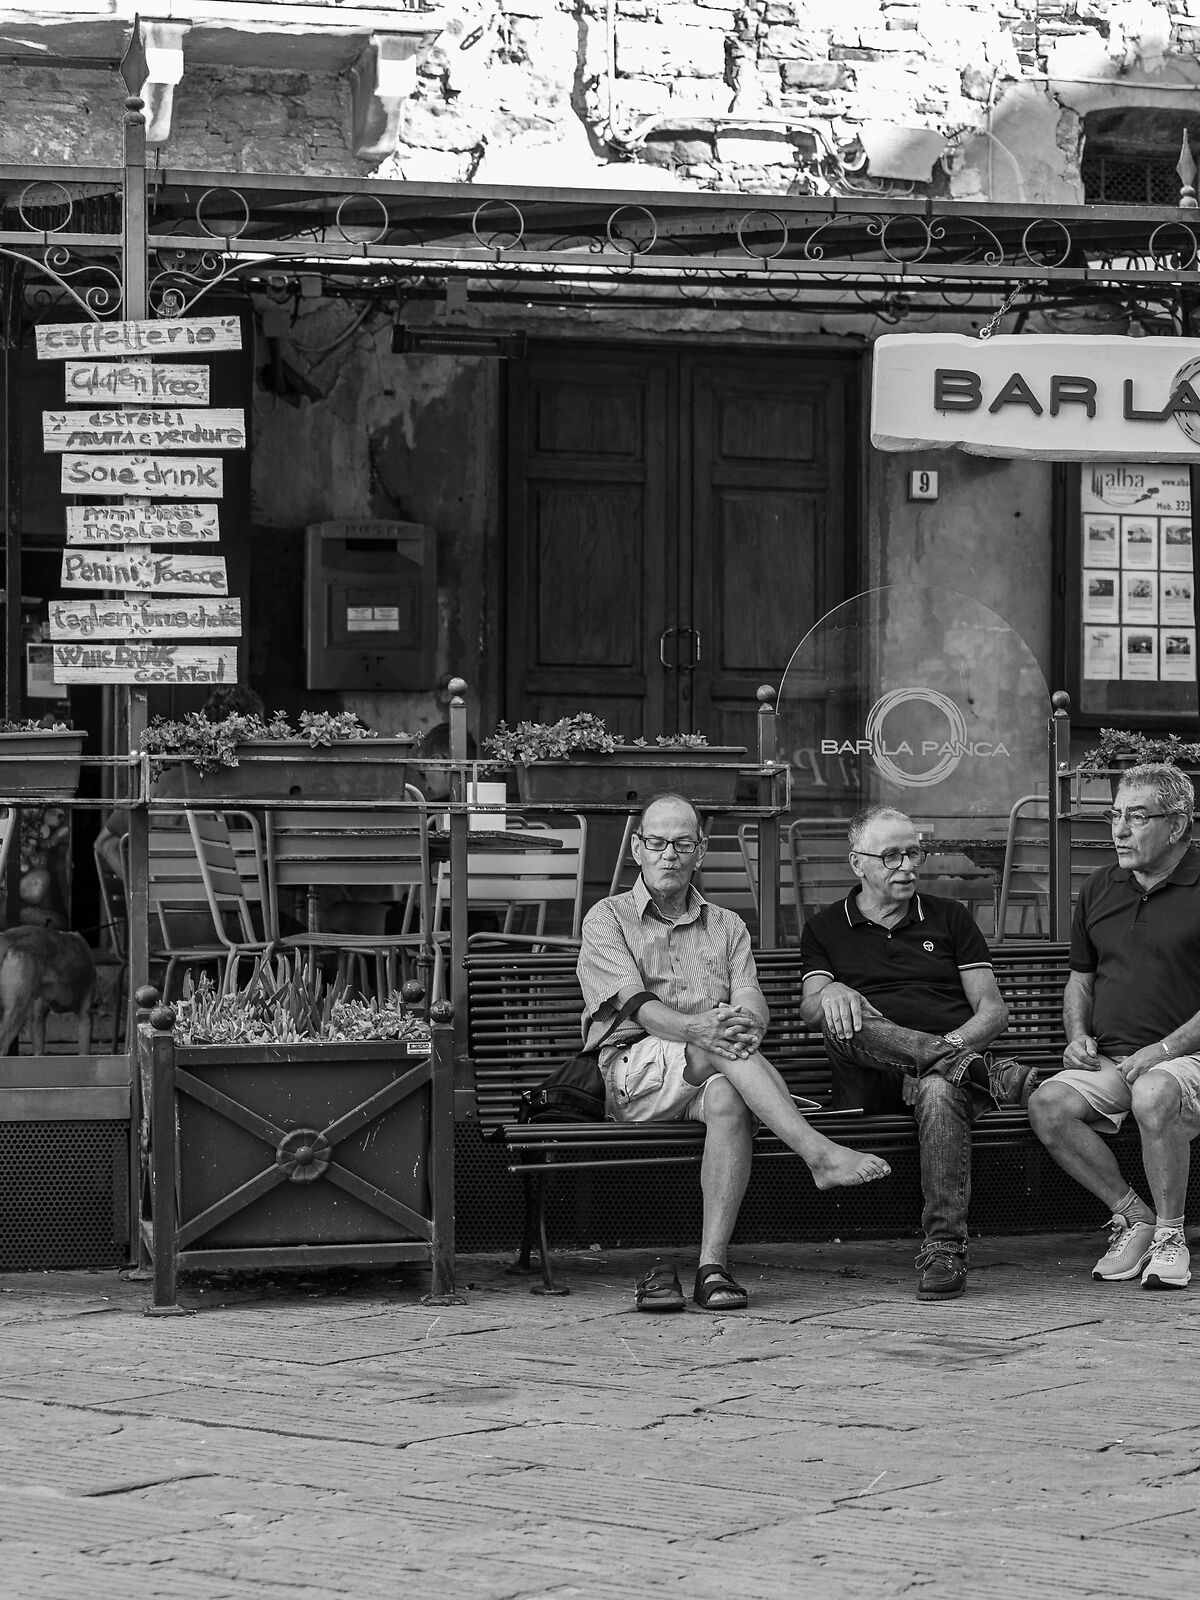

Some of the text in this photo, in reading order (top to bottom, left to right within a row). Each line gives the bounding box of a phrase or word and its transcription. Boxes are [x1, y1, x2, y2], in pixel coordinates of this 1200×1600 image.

[933, 368, 1098, 418] BAR
[68, 461, 218, 489] Soia drink
[919, 472, 930, 493] 9
[1105, 466, 1145, 488] alba
[65, 553, 141, 583] Panini
[821, 739, 1011, 757] BAR LA PANCA
